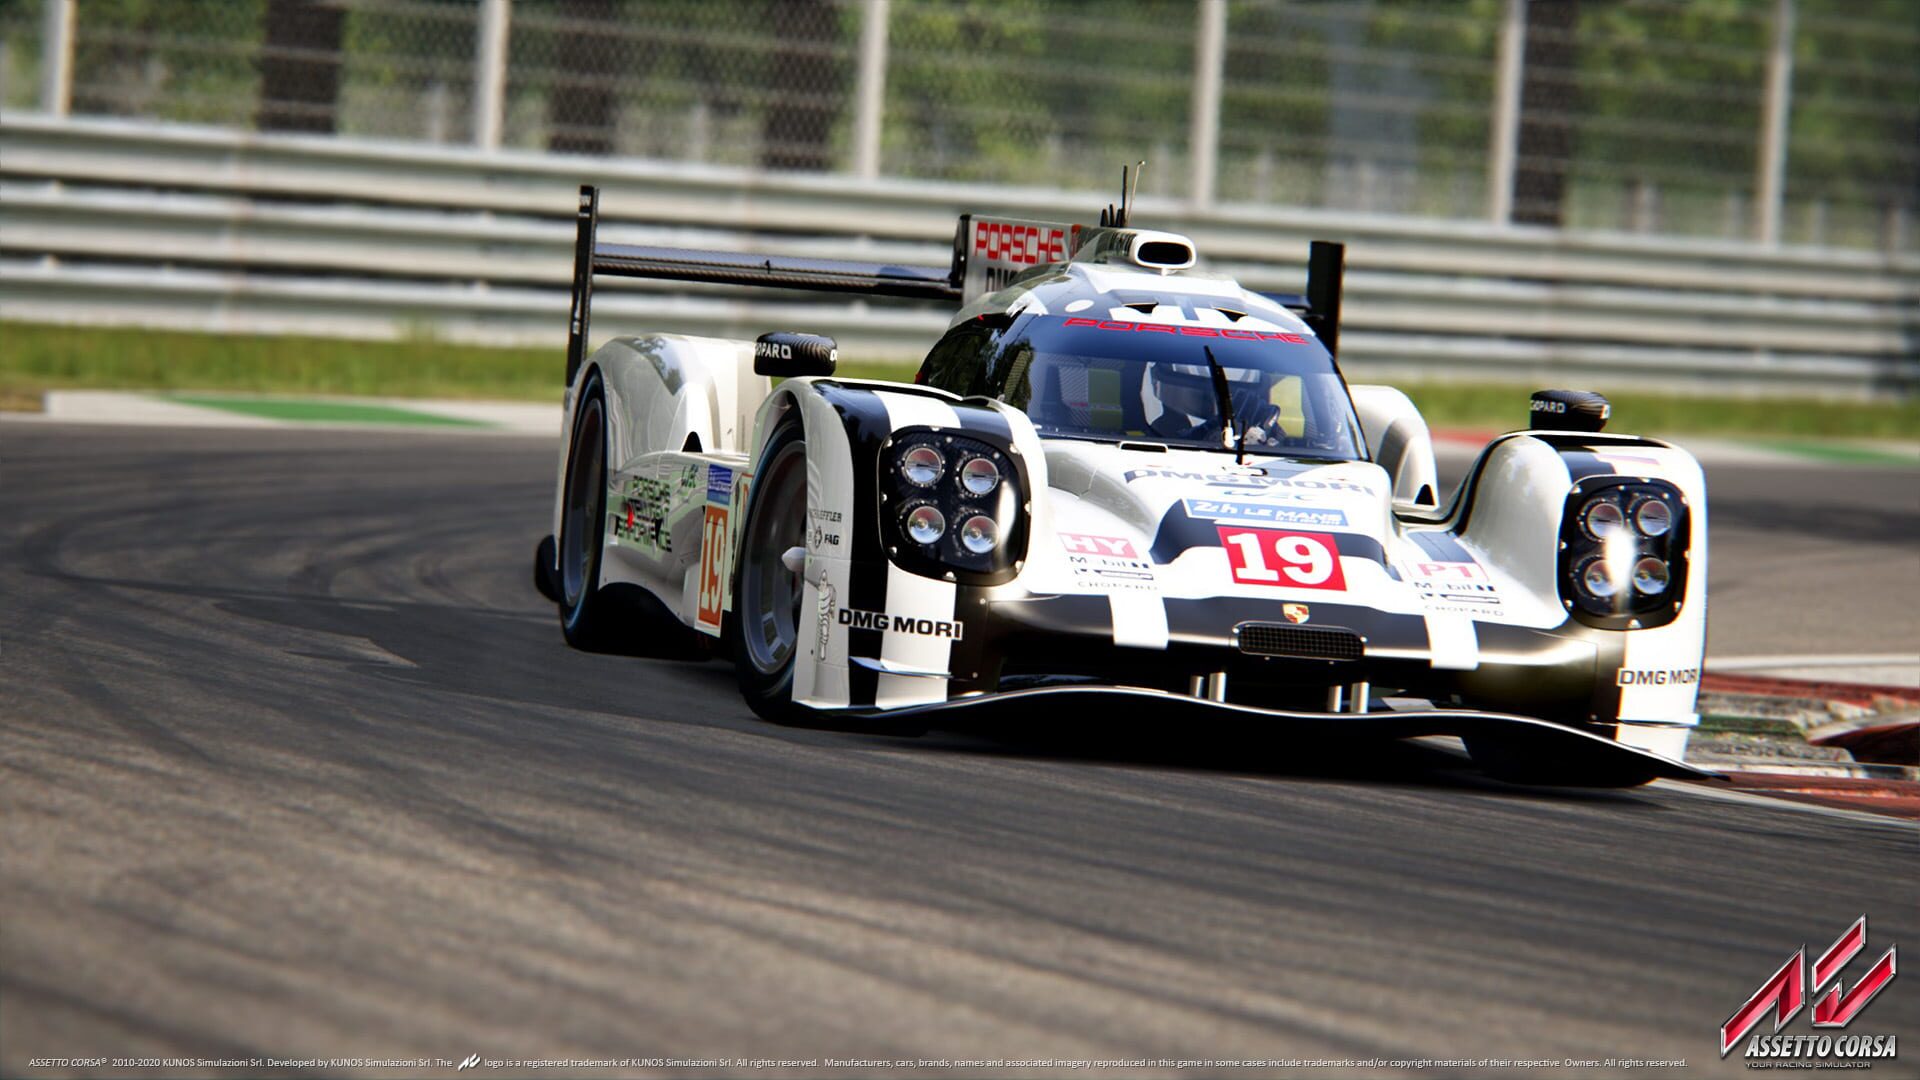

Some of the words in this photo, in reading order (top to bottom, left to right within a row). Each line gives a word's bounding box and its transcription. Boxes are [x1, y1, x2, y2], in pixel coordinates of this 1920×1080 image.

[974, 221, 1064, 264] PORSCHE
[1063, 317, 1310, 345] PORSCHE
[1243, 508, 1273, 517] LE
[824, 533, 840, 546] FAG
[1059, 533, 1130, 556] HY
[701, 514, 726, 614] 19
[1228, 532, 1334, 585] 19
[838, 608, 889, 631] DMG
[893, 616, 961, 639] MORI
[1619, 669, 1667, 685] DMG
